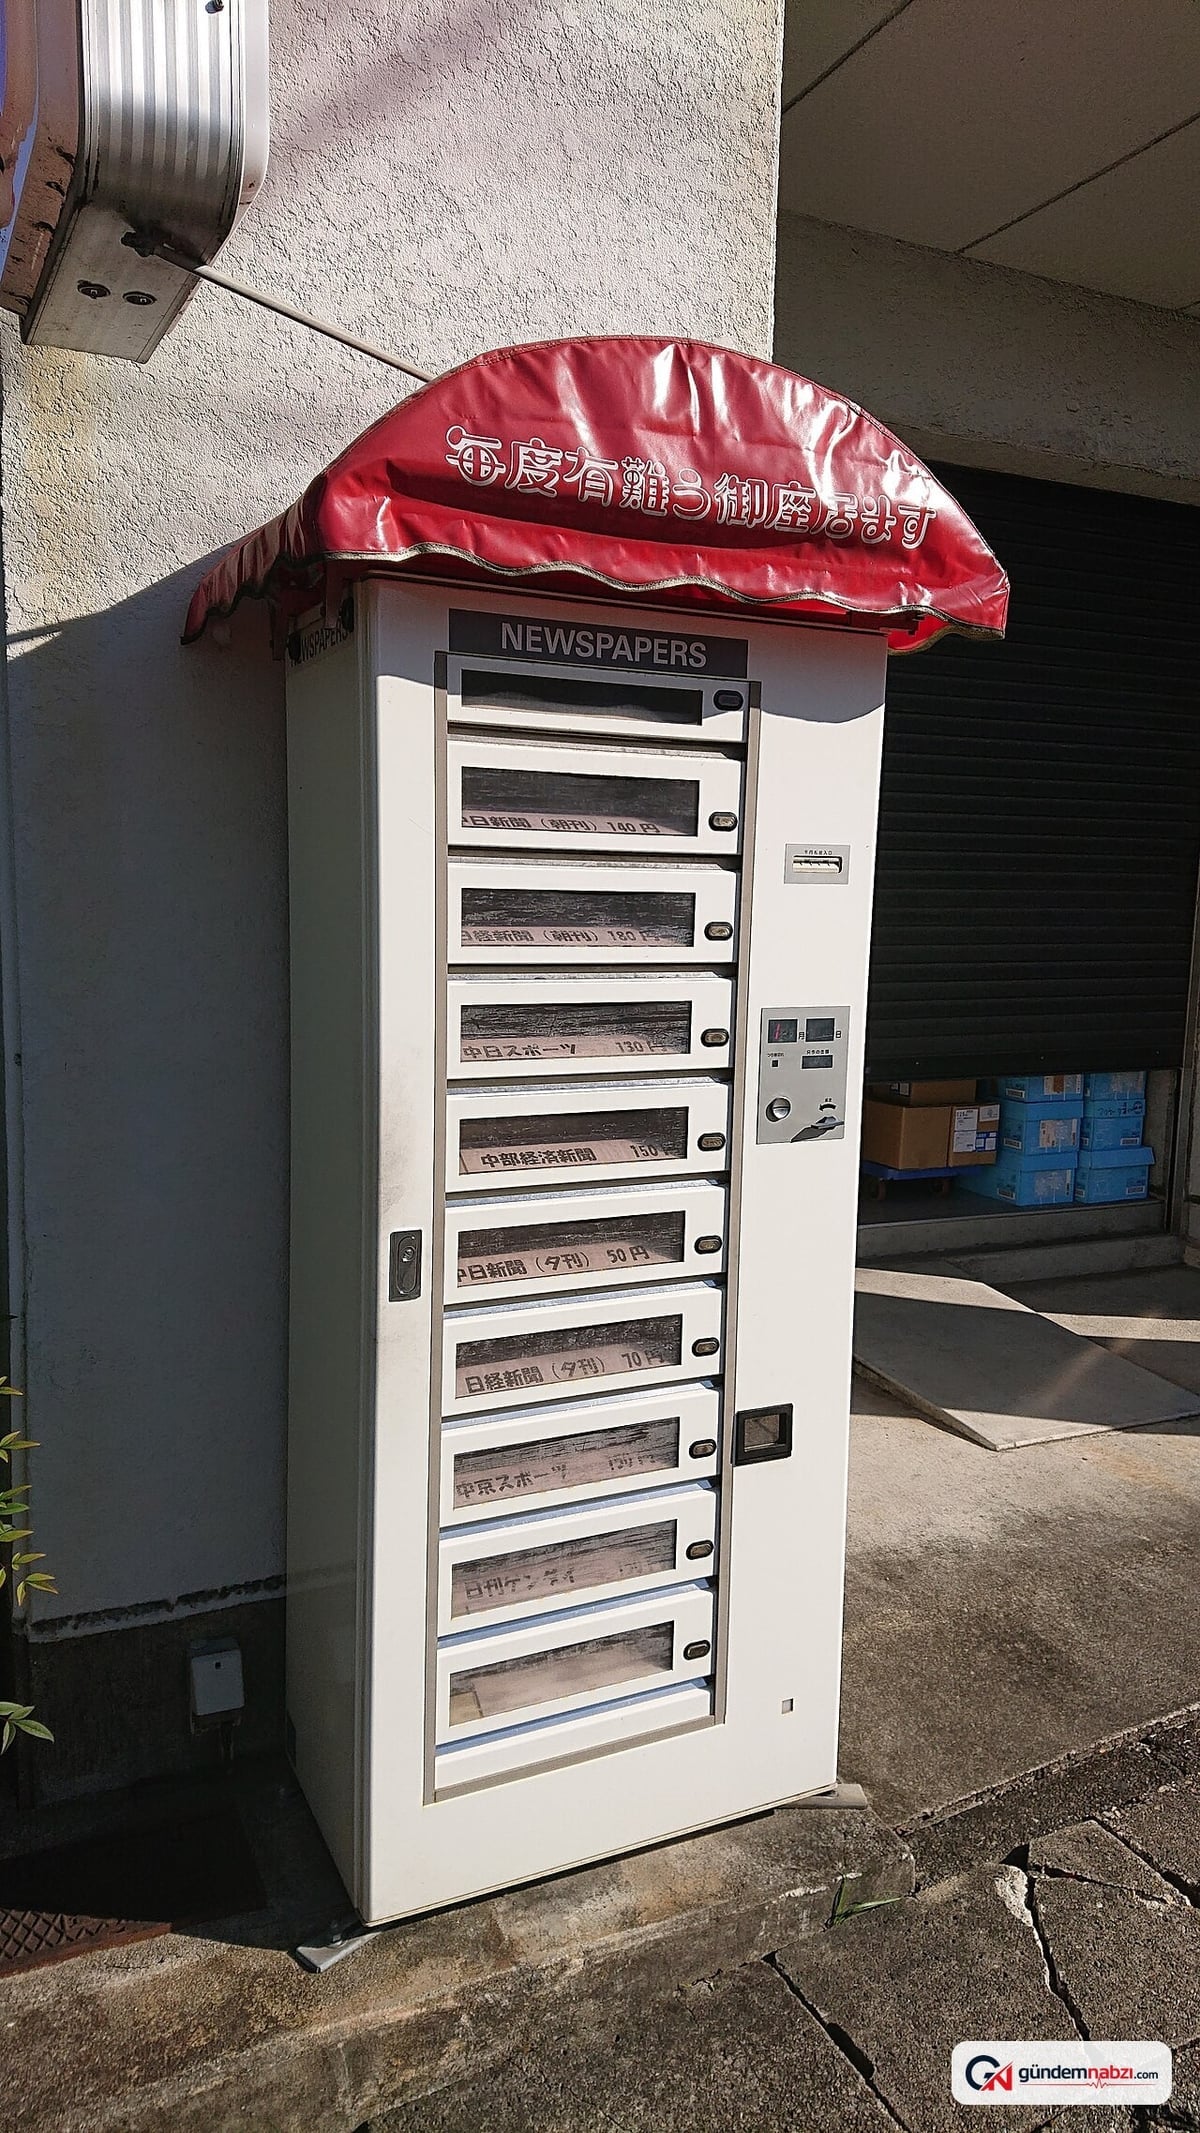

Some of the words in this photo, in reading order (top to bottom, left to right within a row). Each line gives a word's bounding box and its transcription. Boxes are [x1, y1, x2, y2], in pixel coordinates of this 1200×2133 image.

[290, 617, 349, 668] WSPAPER
[501, 622, 708, 668] NEWSPAPERS
[463, 1043, 576, 1059] 中日スポーツ
[481, 1147, 597, 1168] 中部経済新聞
[464, 1356, 606, 1394] 日経新聞（夕刊）
